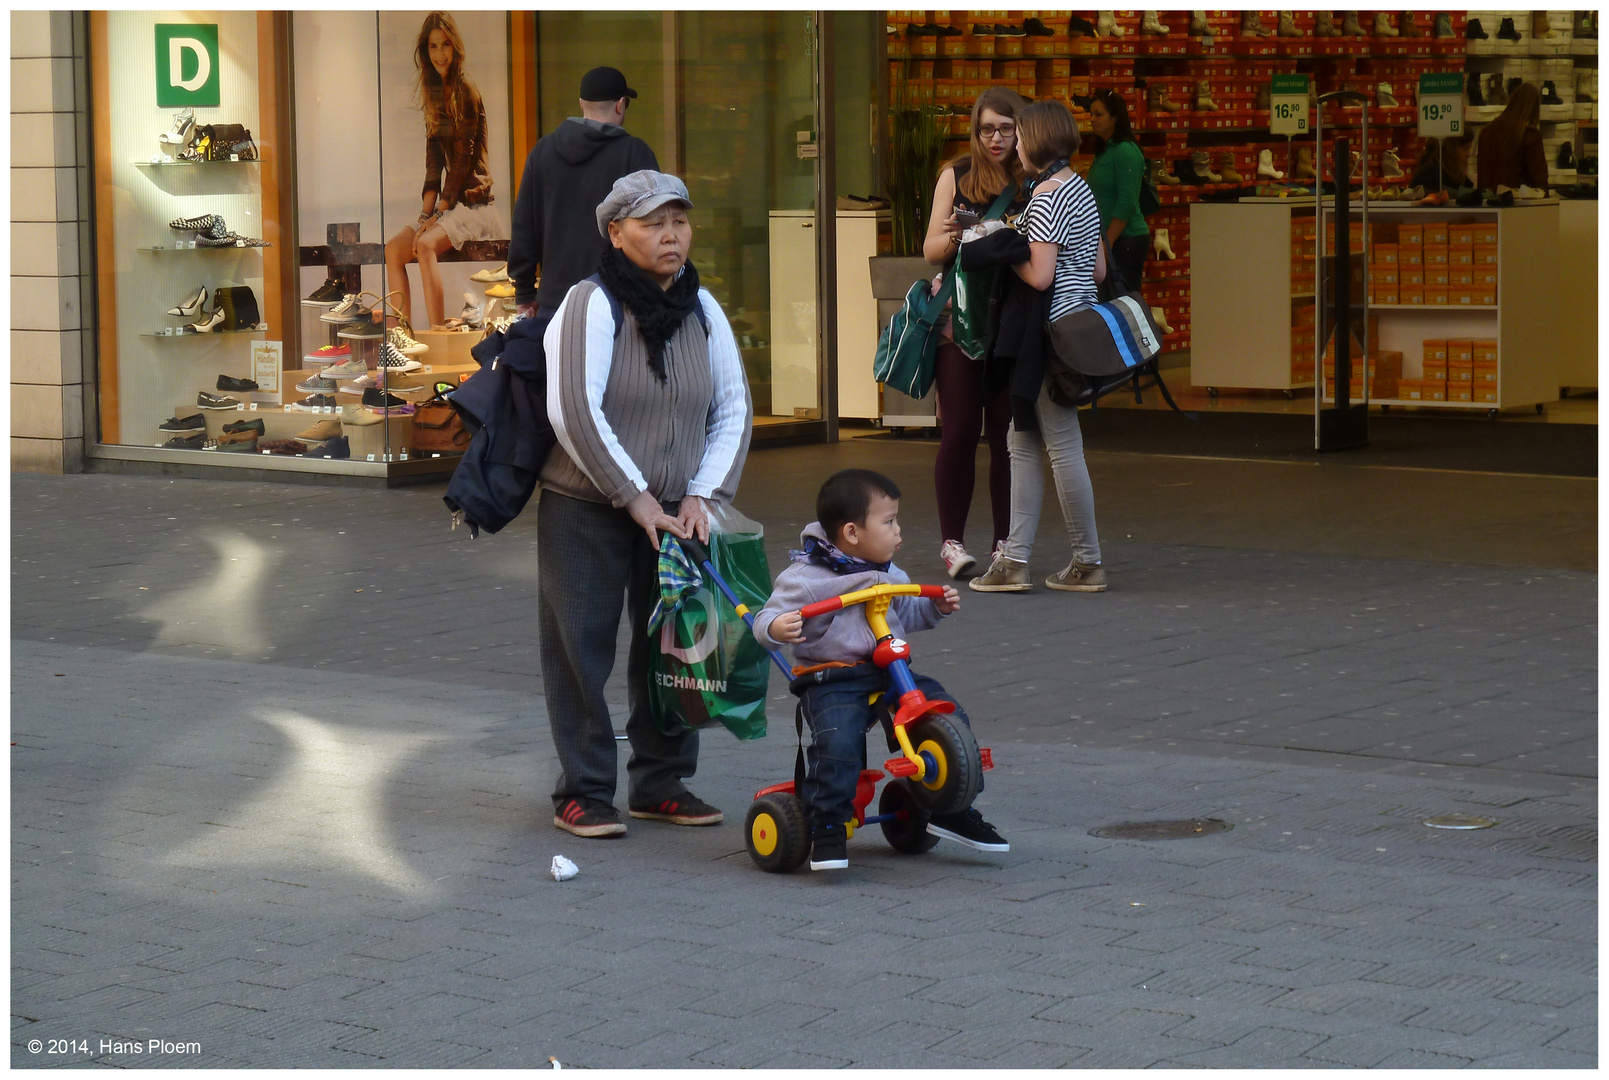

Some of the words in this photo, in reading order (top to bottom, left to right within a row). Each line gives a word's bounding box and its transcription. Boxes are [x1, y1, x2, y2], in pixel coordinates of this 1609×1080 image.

[168, 37, 211, 92] D
[1275, 80, 1289, 88] Jedes
[1423, 80, 1440, 88] Jedes
